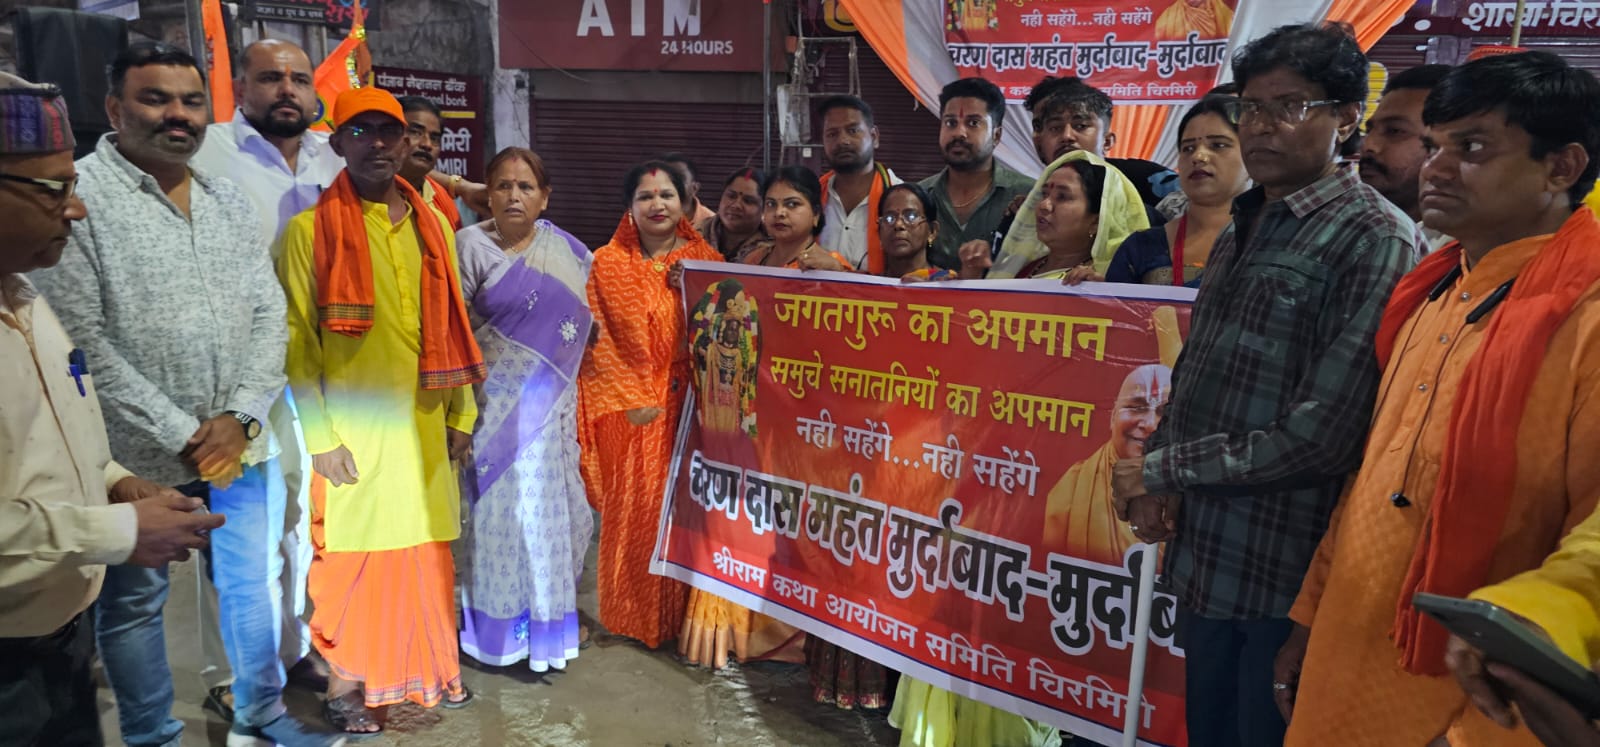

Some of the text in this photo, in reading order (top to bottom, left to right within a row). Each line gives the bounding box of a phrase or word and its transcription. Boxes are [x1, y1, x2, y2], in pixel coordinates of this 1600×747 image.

[660, 40, 734, 55] 24 HOURS
[990, 43, 1028, 73] दास
[1028, 32, 1076, 74] महंत
[435, 158, 468, 176] MIRI
[907, 303, 953, 344] का
[966, 308, 1113, 361] अपमान
[770, 351, 1095, 437] समुचे सनातनियों का अपमान
[796, 408, 836, 449] नही
[973, 446, 1041, 496] सहेंगे
[688, 450, 742, 521] चरण
[744, 469, 806, 536] दास
[806, 472, 888, 566] महंत
[712, 546, 767, 589] श्रीराम
[772, 573, 818, 608] कथा
[825, 598, 918, 649] आयोजन
[926, 632, 1016, 684] समिति
